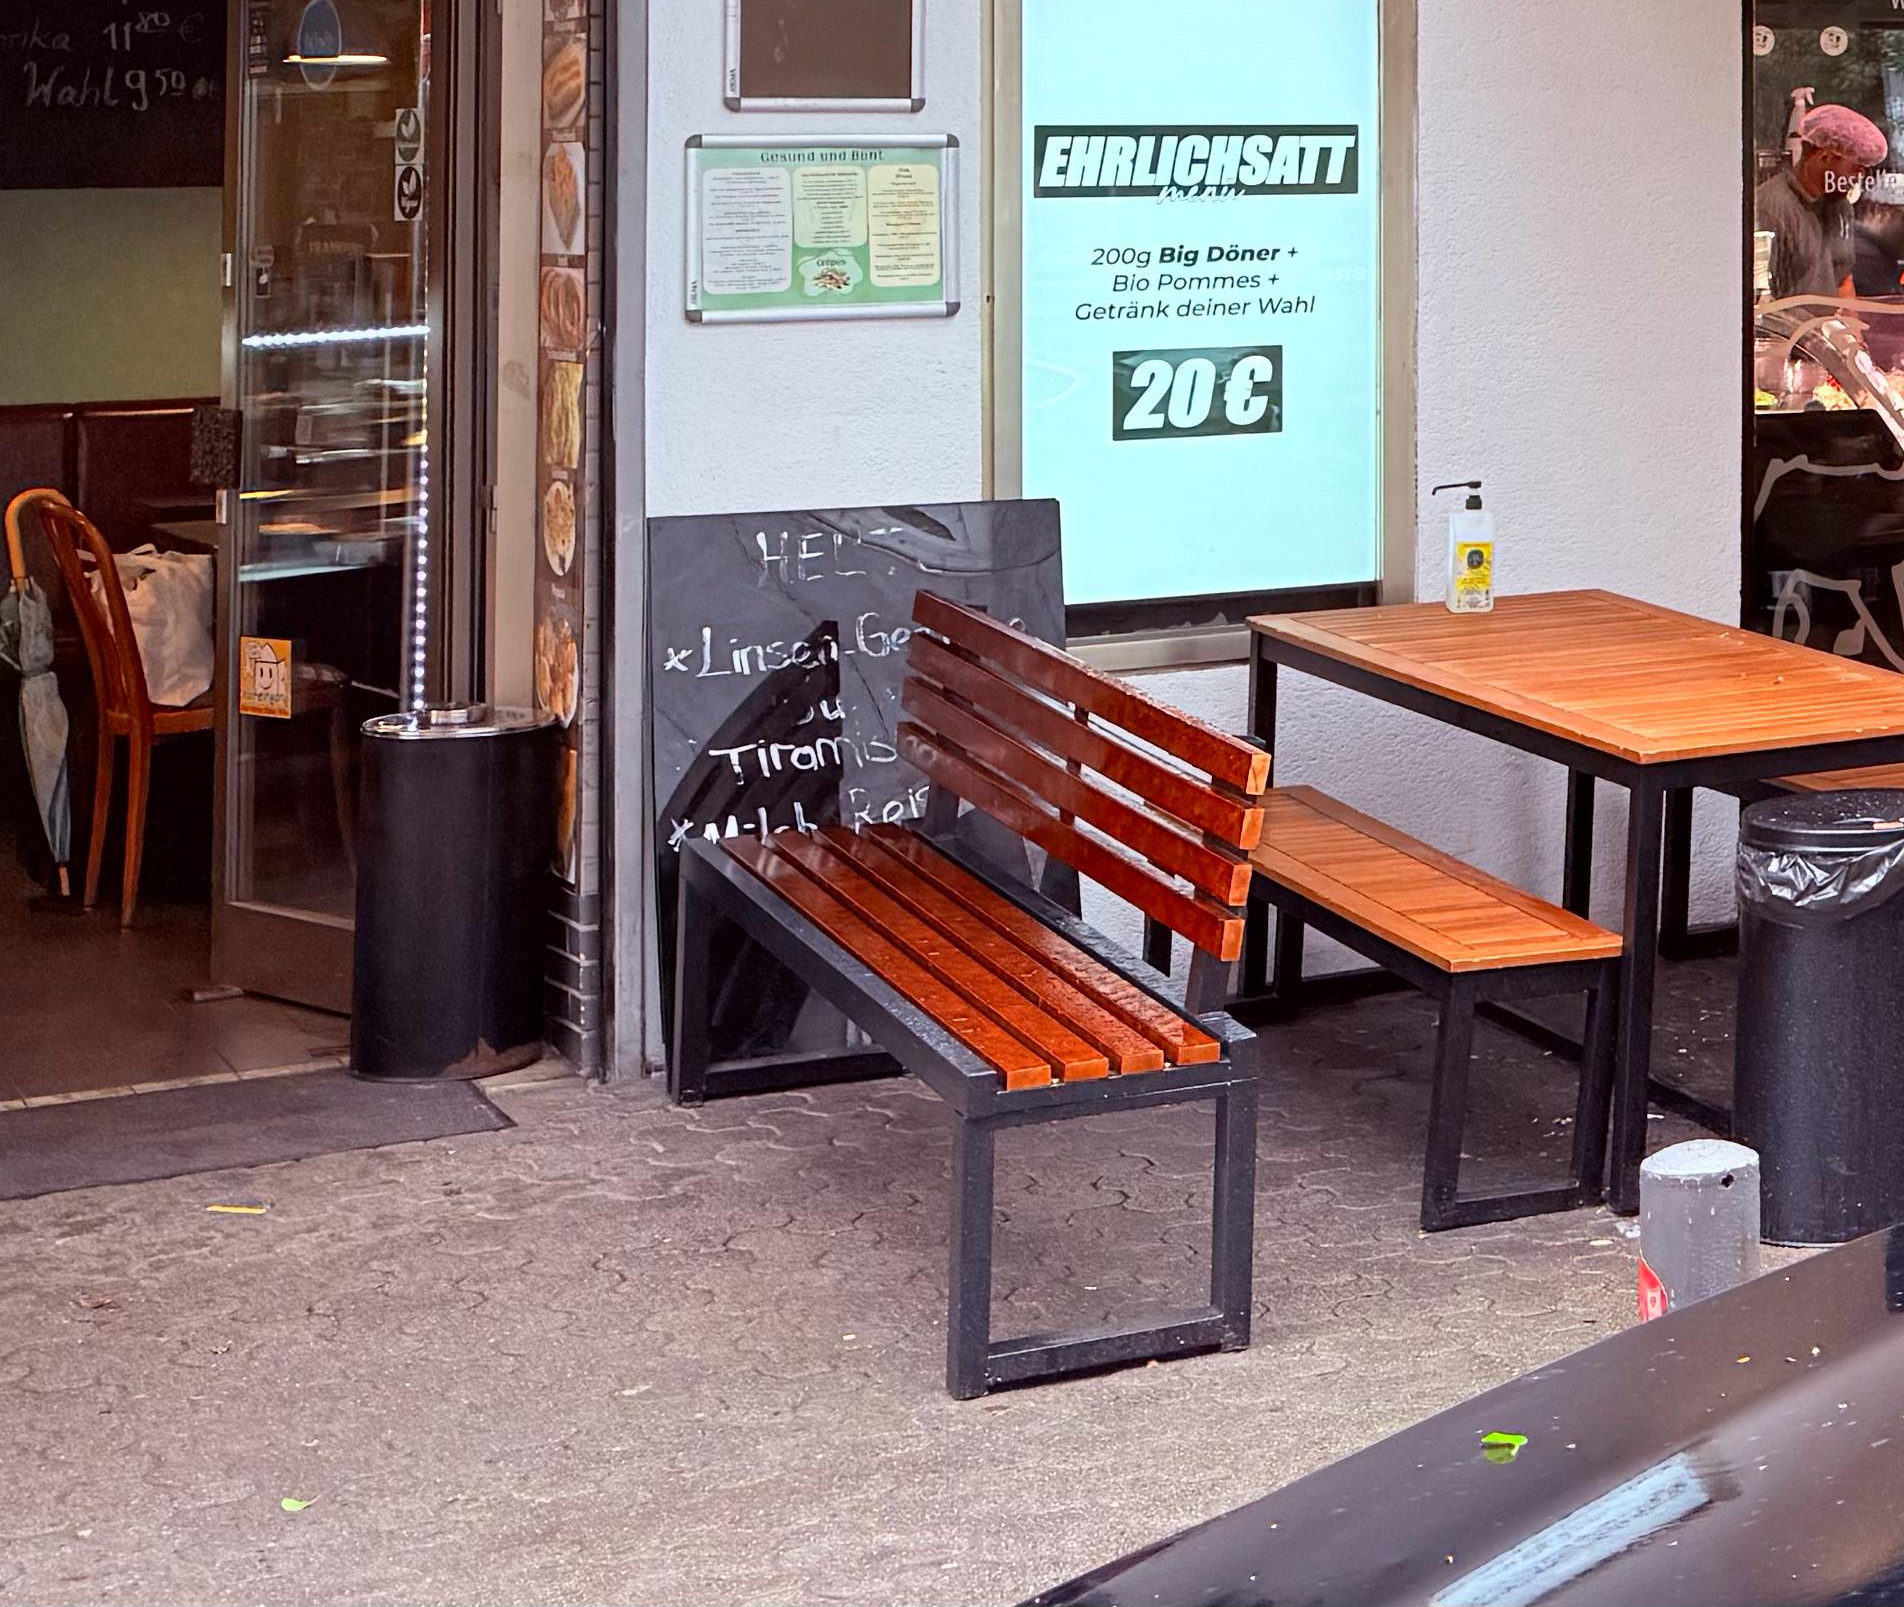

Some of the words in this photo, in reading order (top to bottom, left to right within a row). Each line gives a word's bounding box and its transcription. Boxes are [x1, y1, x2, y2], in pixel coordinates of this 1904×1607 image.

[760, 151, 815, 163] Gesund
[820, 150, 847, 162] und
[851, 150, 885, 161] Bunt
[1039, 134, 1357, 189] EHRLICHSATT
[1091, 247, 1152, 269] 200g
[1159, 244, 1199, 268] Big
[1207, 240, 1280, 263] Döner
[1286, 246, 1299, 259] +
[1112, 271, 1152, 292] Bio
[1158, 272, 1262, 292] Pommes
[1267, 274, 1280, 286] +
[1075, 298, 1170, 322] Getränk
[1176, 297, 1249, 318] deiner
[1257, 295, 1316, 316] Wahl
[1124, 355, 1216, 431] 20
[1223, 354, 1273, 427] €
[696, 612, 950, 678] Linsen-Ge
